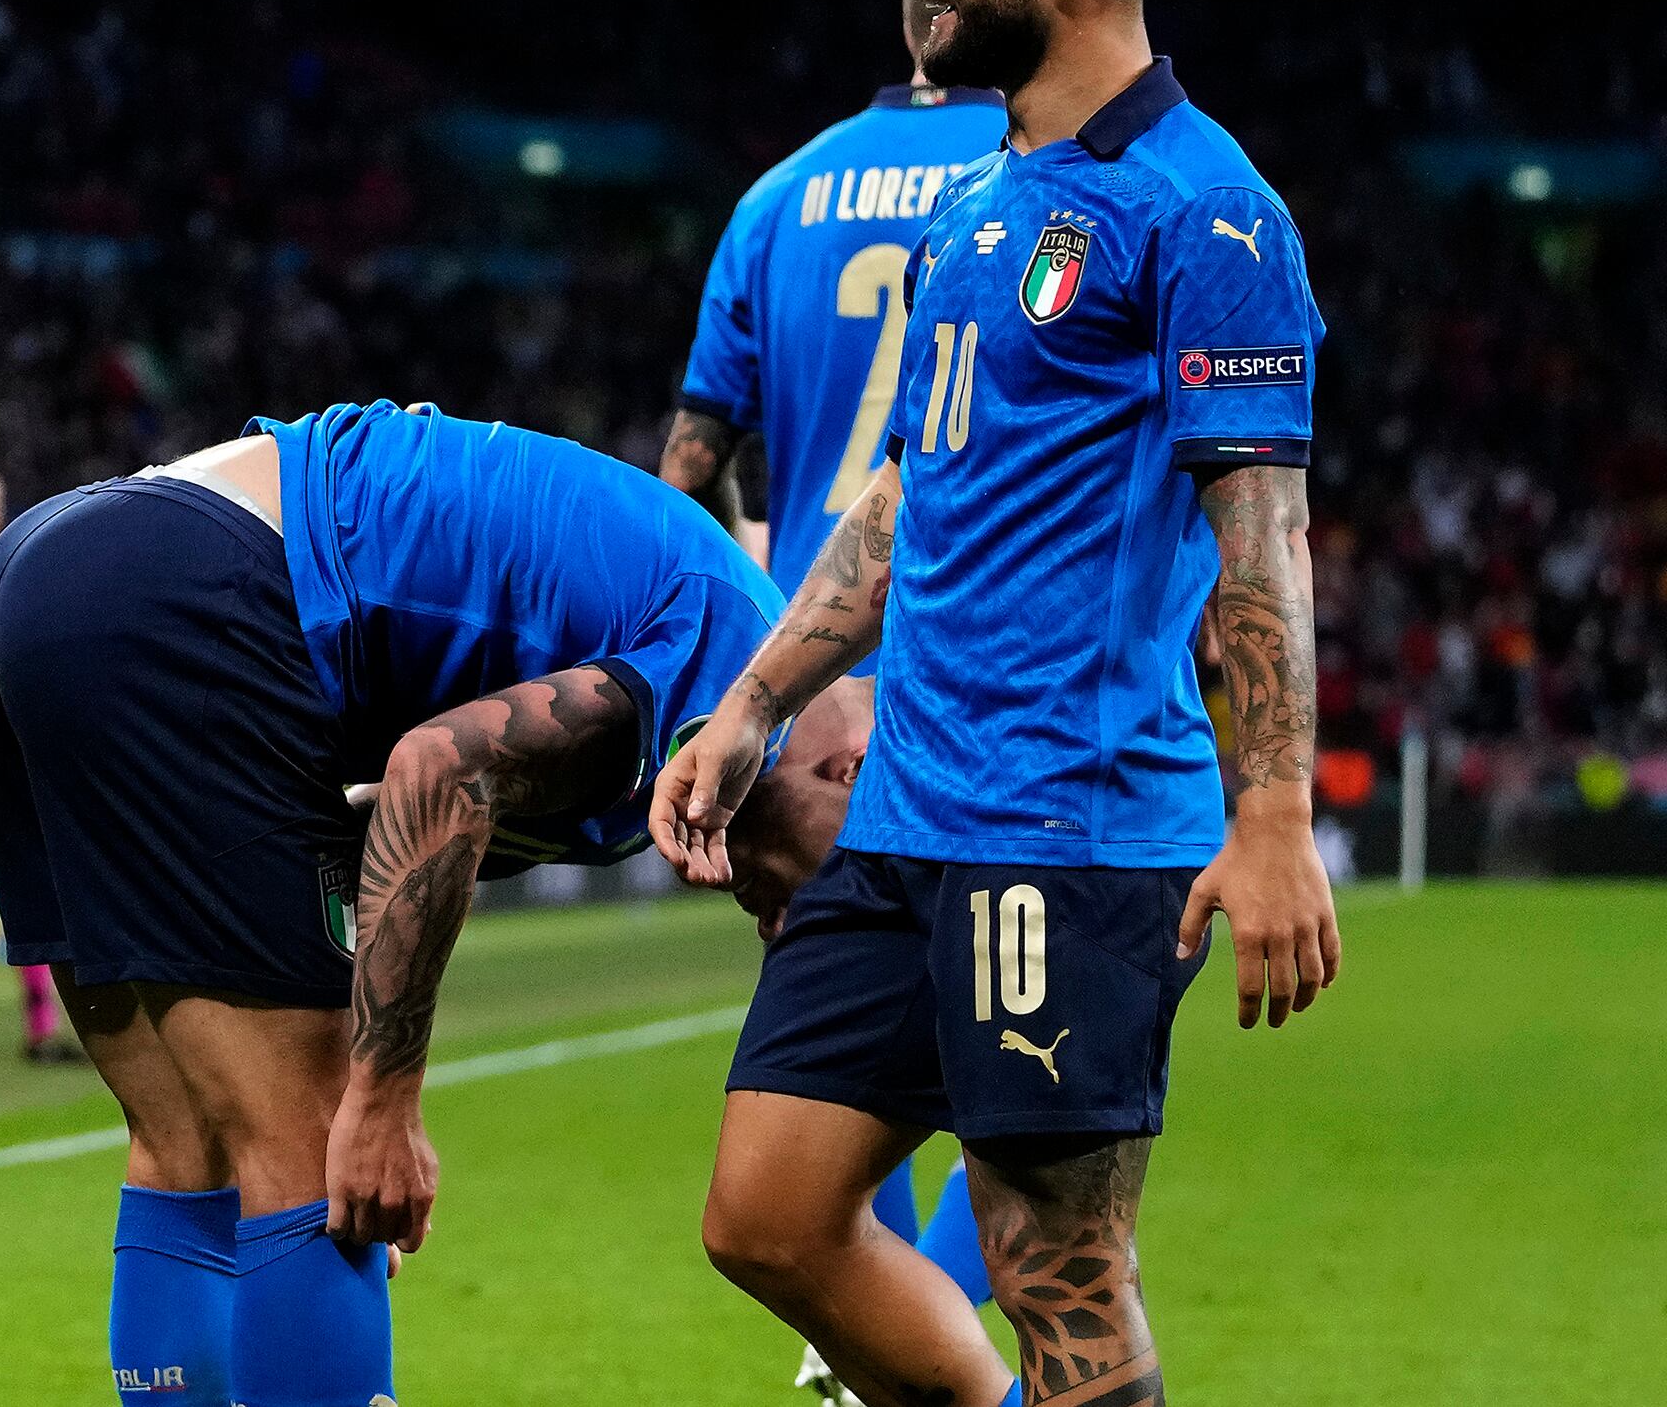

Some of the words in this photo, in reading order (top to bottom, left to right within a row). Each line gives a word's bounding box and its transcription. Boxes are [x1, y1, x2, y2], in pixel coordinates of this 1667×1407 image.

[1043, 233, 1085, 252] ITALIA
[823, 243, 911, 514] 2
[921, 321, 978, 453] 10
[1214, 355, 1304, 377] RESPECT
[970, 883, 1047, 1022] 10
[112, 1365, 184, 1387] TALIA
